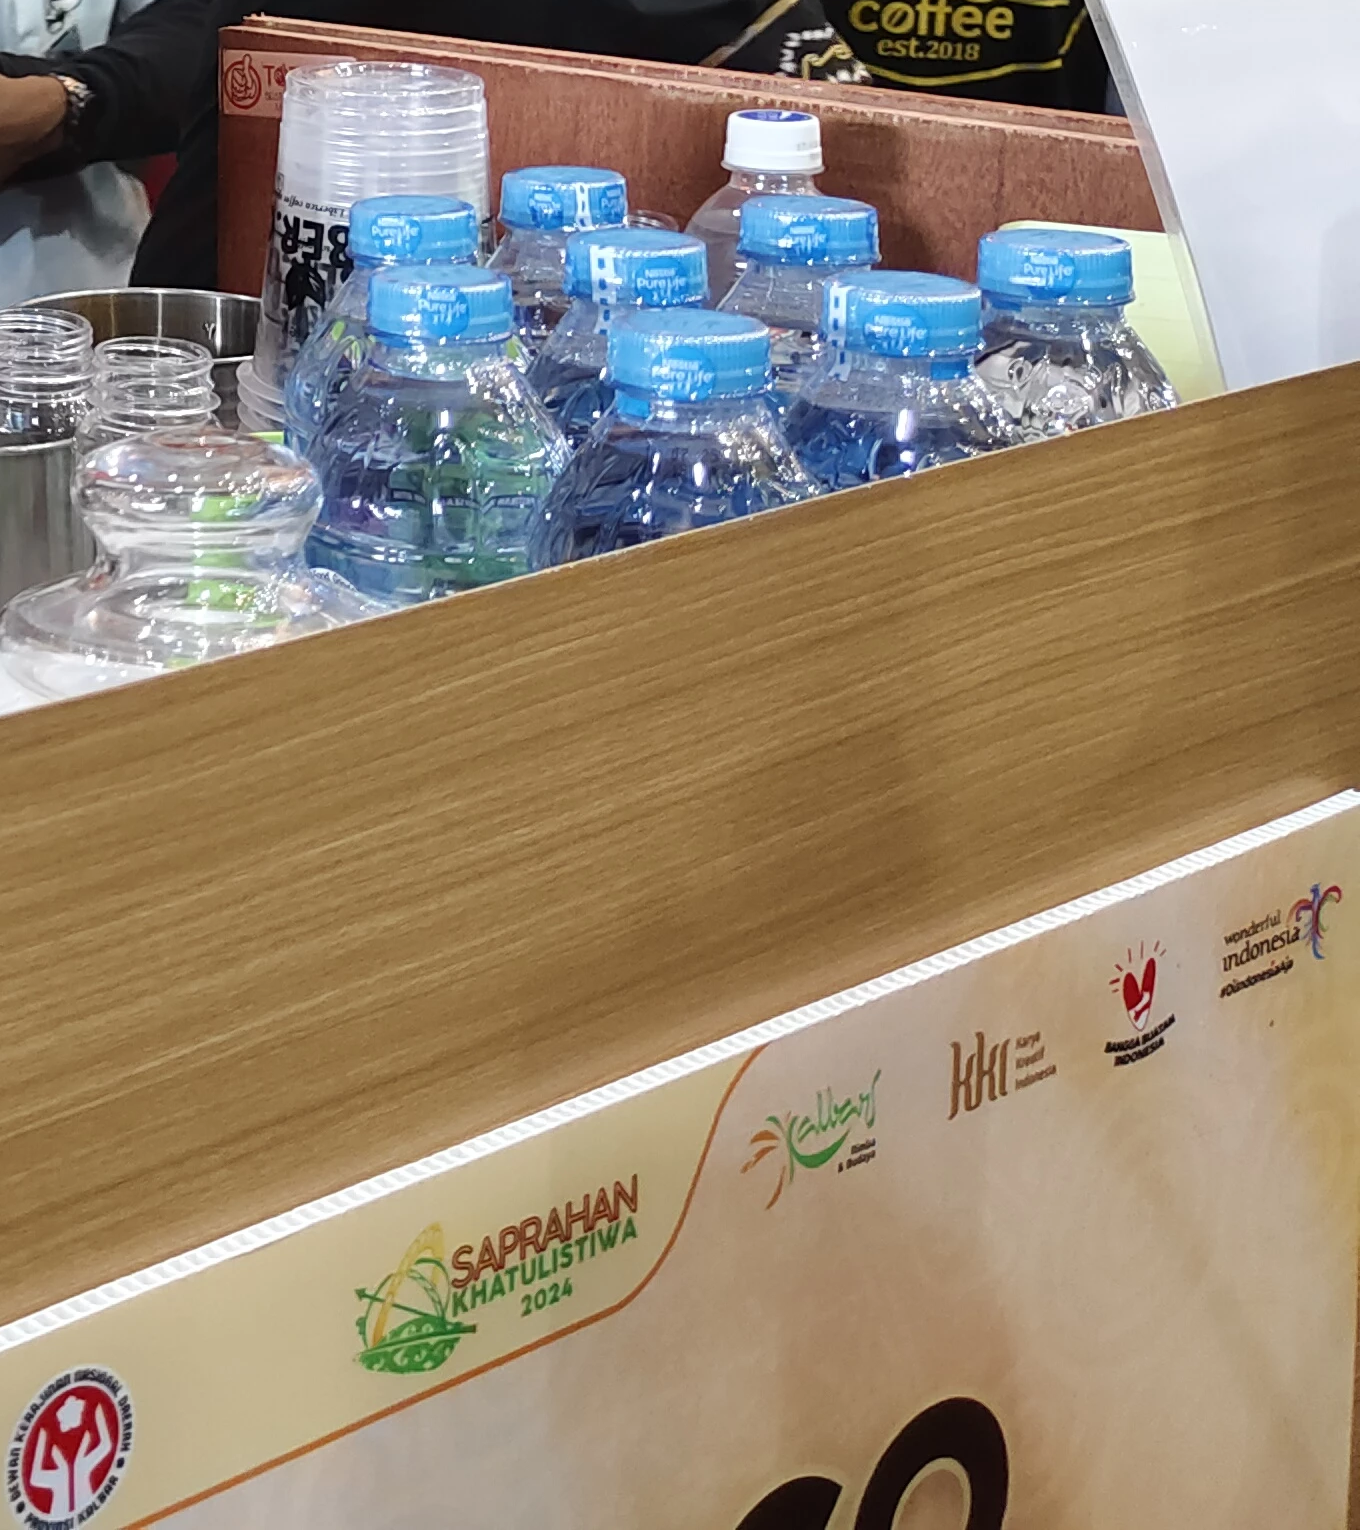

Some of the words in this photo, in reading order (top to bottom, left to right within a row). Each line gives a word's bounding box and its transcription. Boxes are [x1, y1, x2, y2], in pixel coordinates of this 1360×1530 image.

[1222, 926, 1301, 972] indonesia
[1224, 908, 1282, 946] wonderful
[451, 1173, 638, 1289] SAPRAHAN
[451, 1216, 638, 1318] KHATULISTIWA
[520, 1276, 574, 1317] 2024
